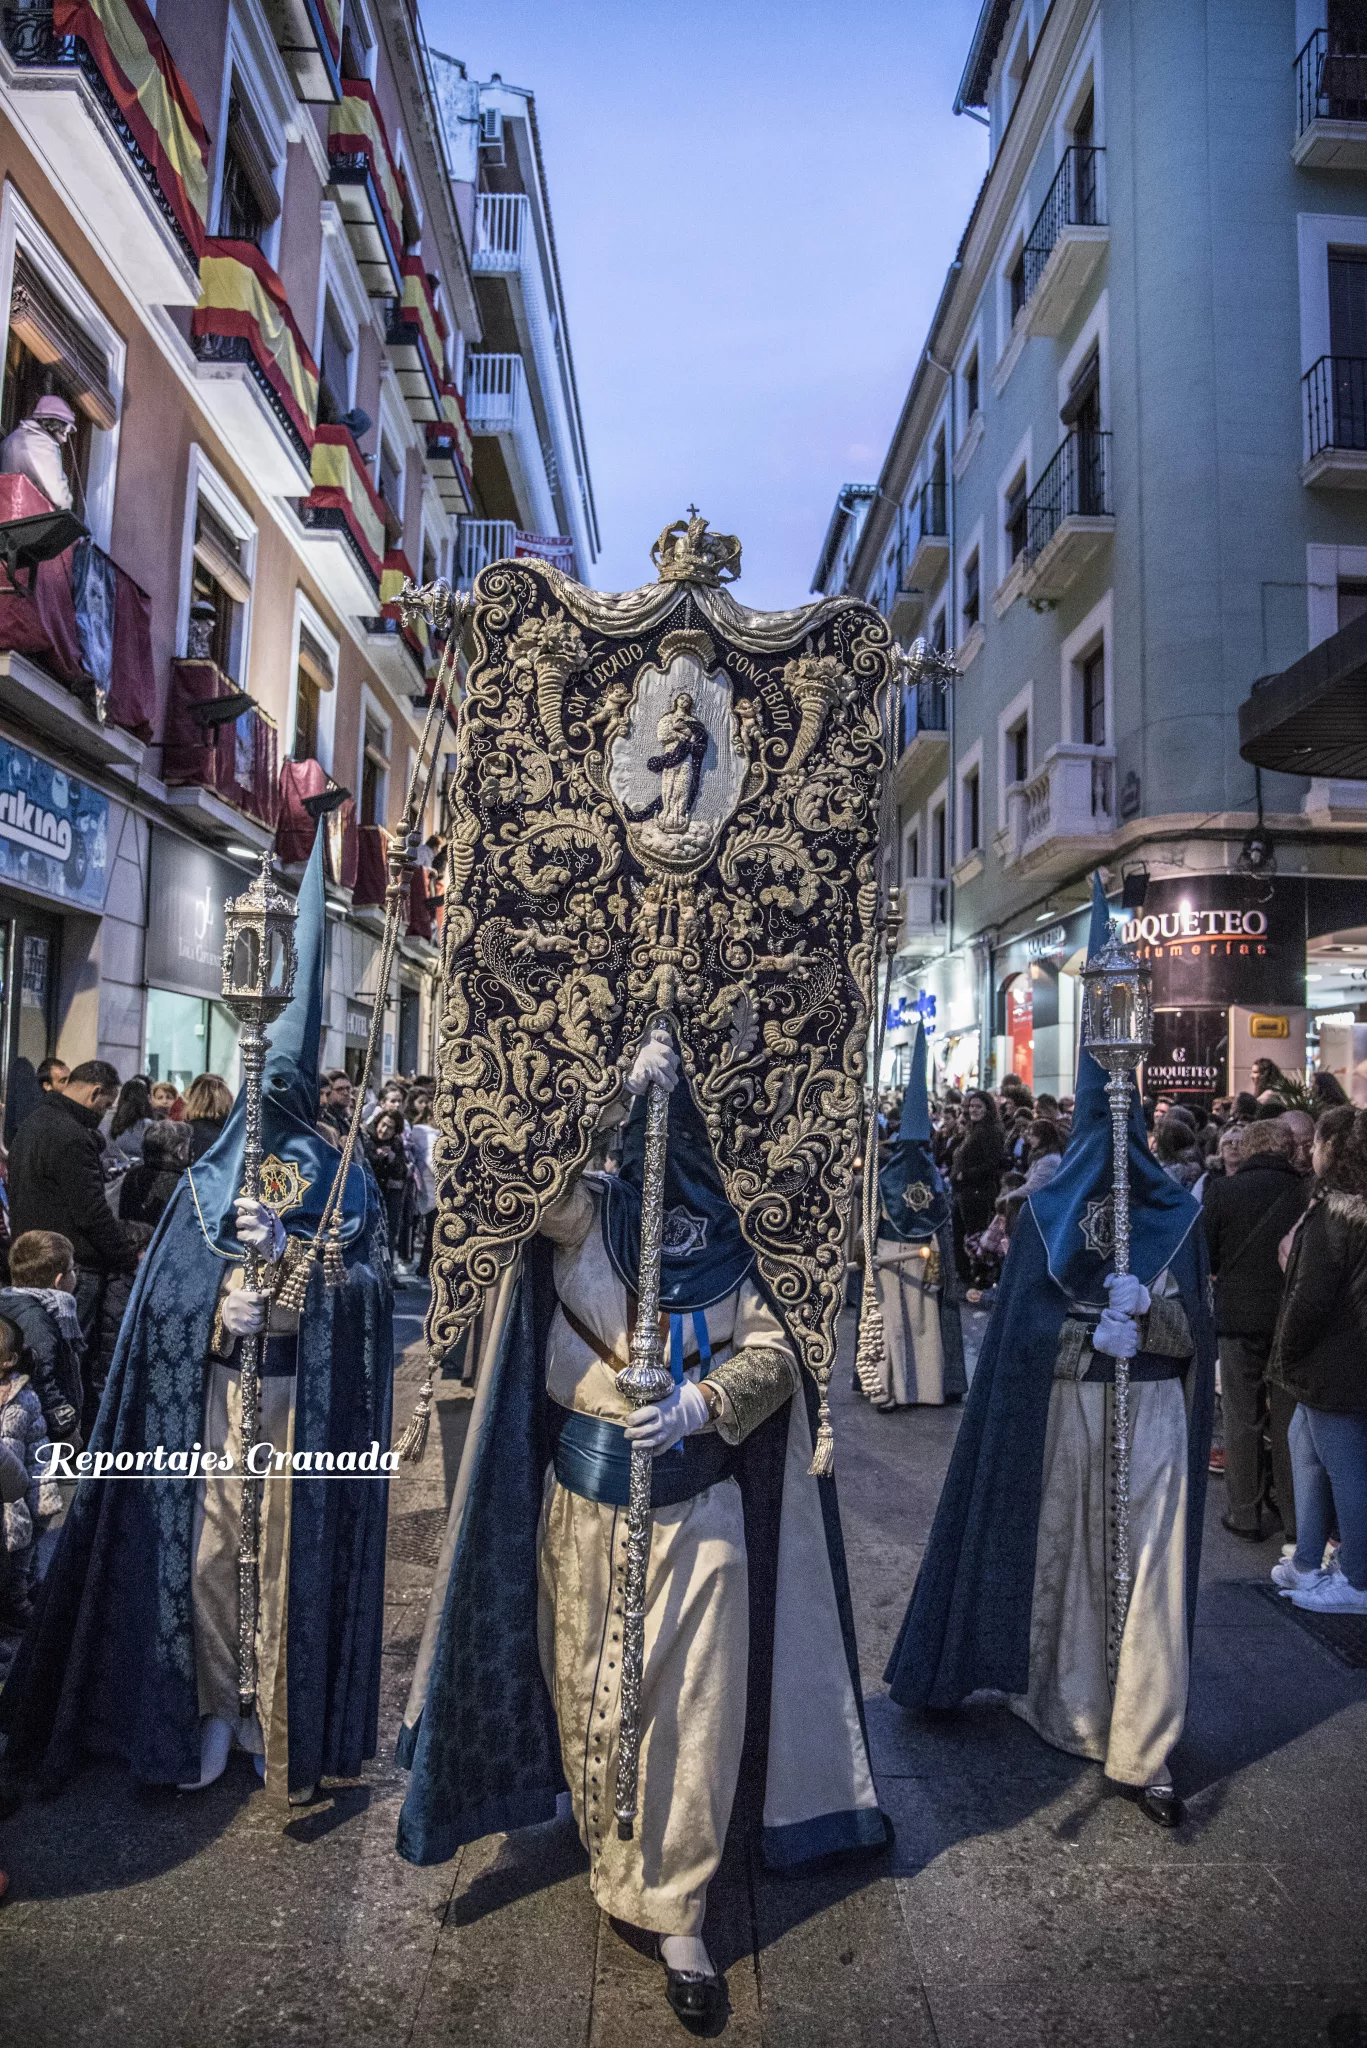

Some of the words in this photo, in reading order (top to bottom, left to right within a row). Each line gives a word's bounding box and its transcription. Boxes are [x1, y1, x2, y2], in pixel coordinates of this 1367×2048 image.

[567, 687, 590, 717] SIN
[584, 643, 644, 689] PECADO
[726, 651, 793, 733] CONCEBIDA
[1121, 910, 1268, 946] COQUETEO
[1130, 940, 1266, 960] rfumerías
[1147, 1065, 1218, 1079] COQUETEO
